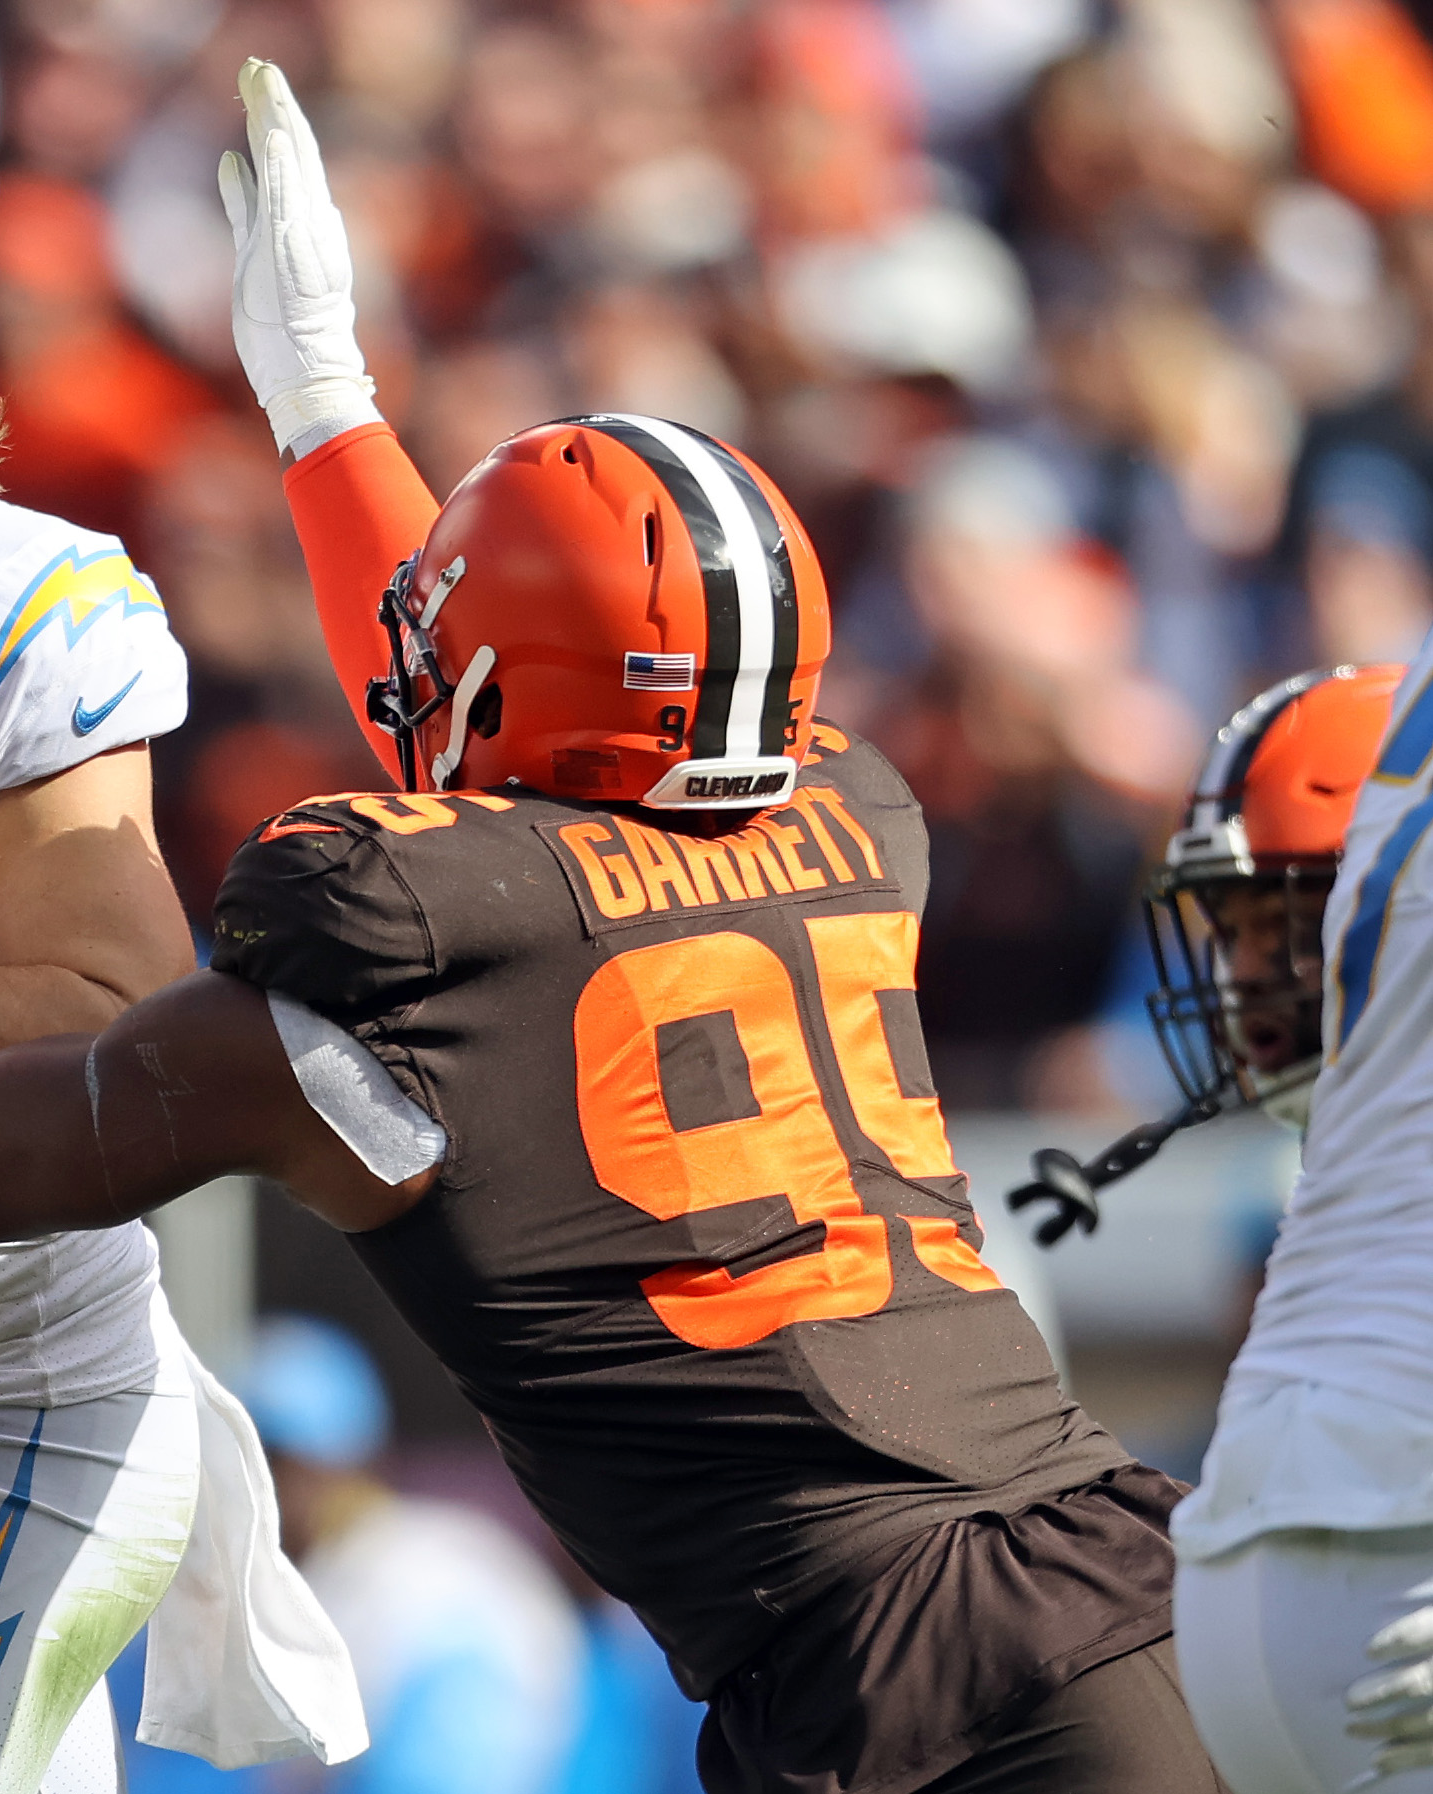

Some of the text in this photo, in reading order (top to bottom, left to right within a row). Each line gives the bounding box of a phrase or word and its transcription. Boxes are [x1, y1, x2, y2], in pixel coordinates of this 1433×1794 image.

[658, 705, 687, 752] 9
[685, 770, 789, 797] CLEVELAND
[558, 785, 884, 920] GARRETT
[573, 910, 1006, 1351] 95
